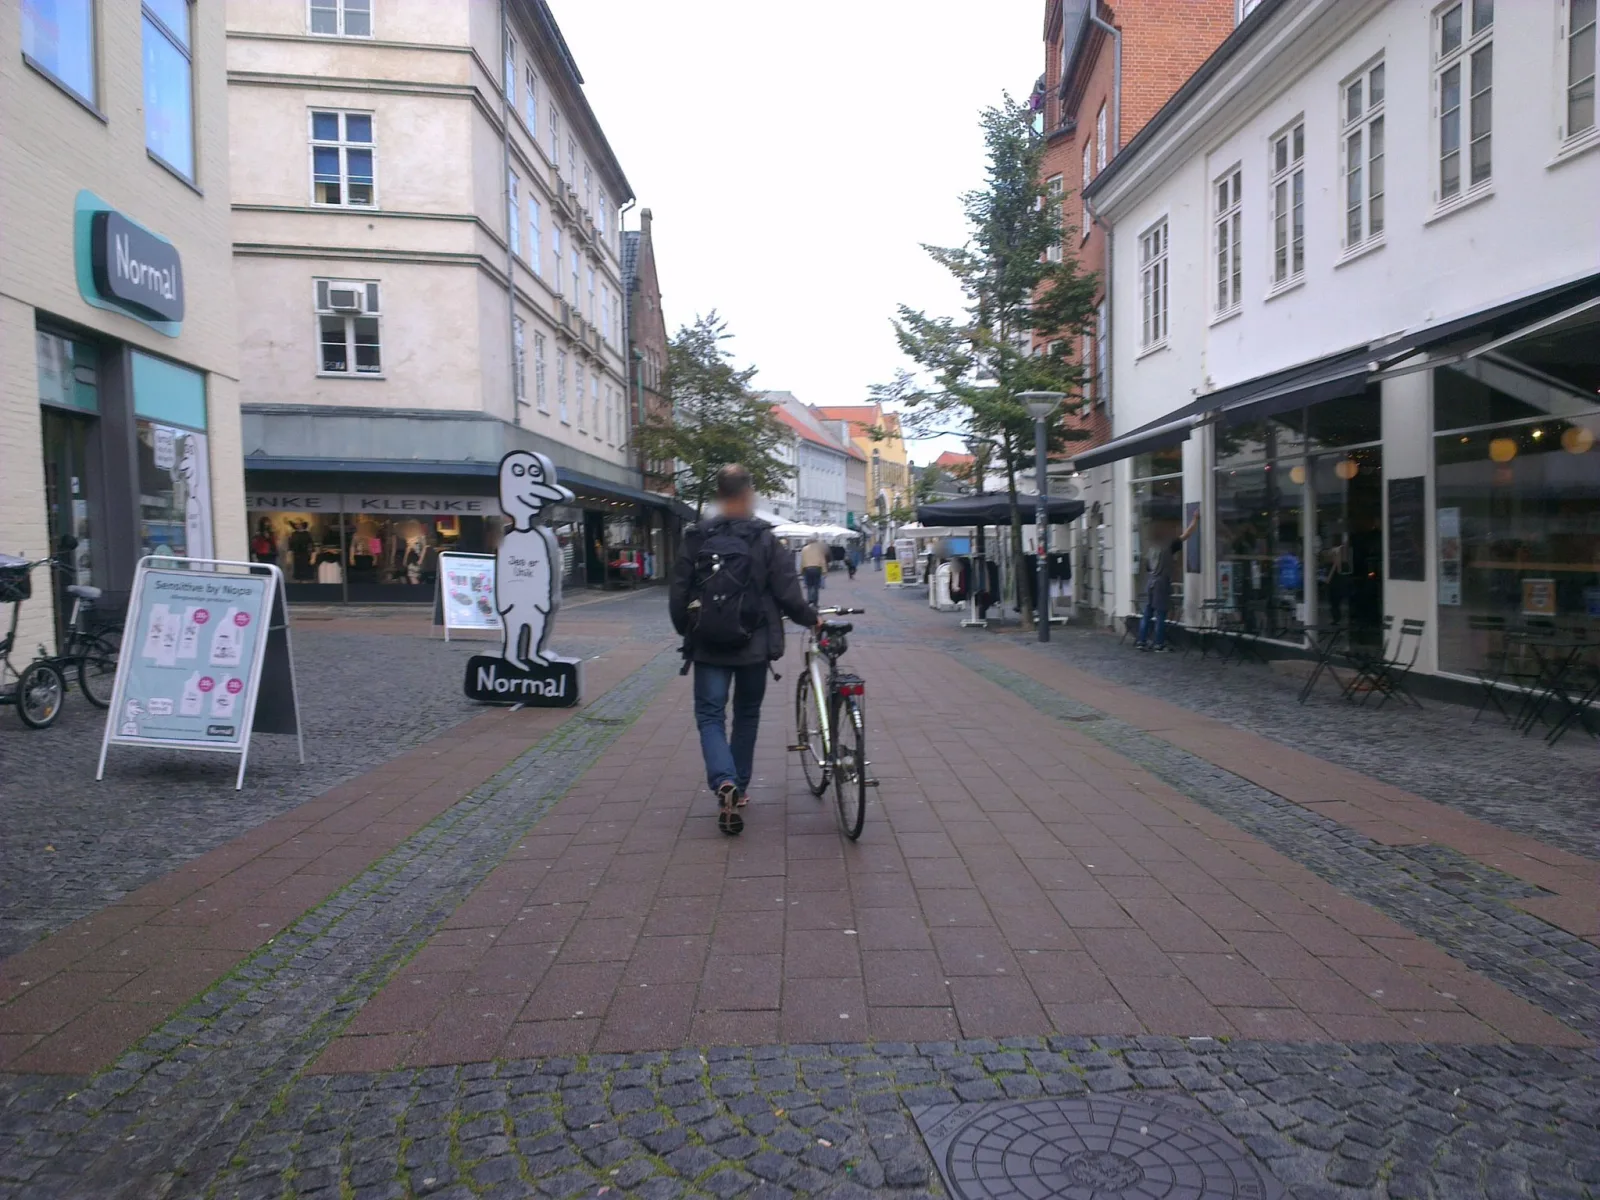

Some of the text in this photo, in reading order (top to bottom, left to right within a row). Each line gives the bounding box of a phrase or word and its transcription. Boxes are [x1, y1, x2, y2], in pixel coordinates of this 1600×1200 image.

[115, 232, 177, 301] Normal
[361, 498, 482, 511] KLENKE
[155, 580, 253, 597] Sensitive by Nopa
[476, 664, 566, 698] Normal
